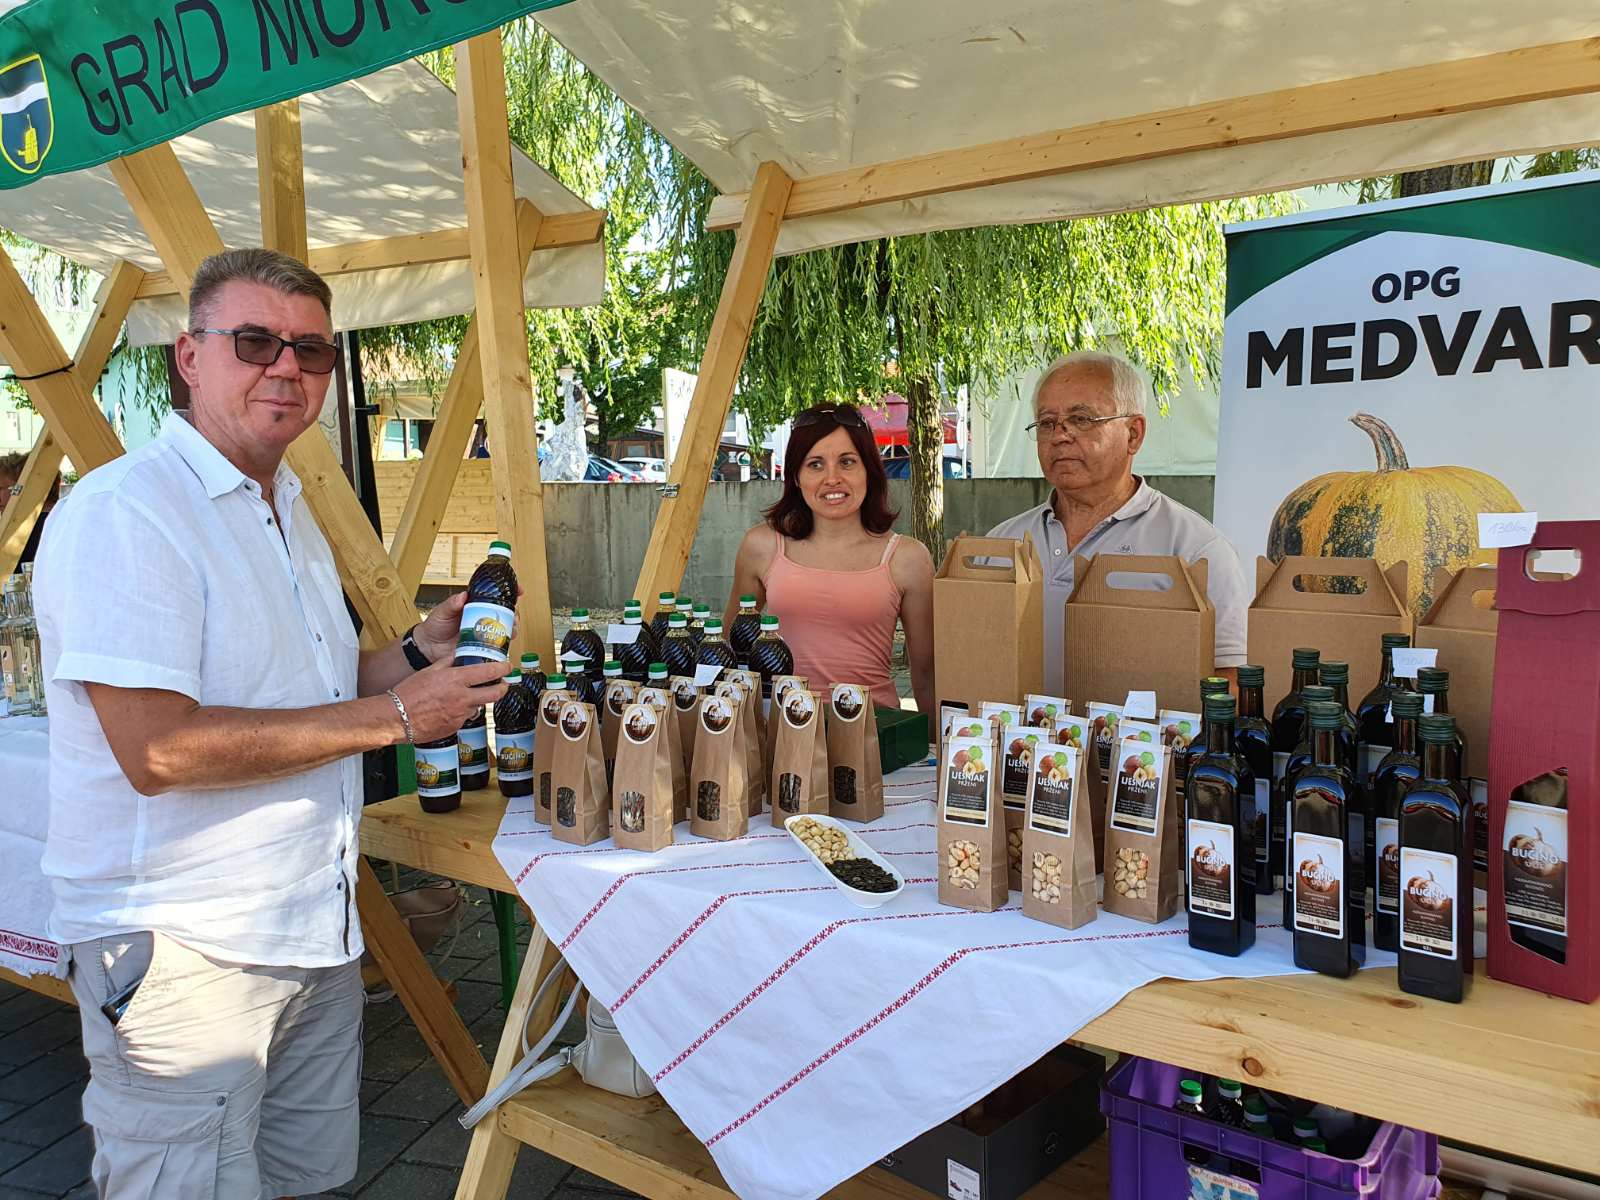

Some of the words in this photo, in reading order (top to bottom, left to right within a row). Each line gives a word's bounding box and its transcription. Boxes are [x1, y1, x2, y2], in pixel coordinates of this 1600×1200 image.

[70, 3, 230, 136] GRAD
[1371, 265, 1461, 304] OPG
[1245, 298, 1600, 389] MEDVAR
